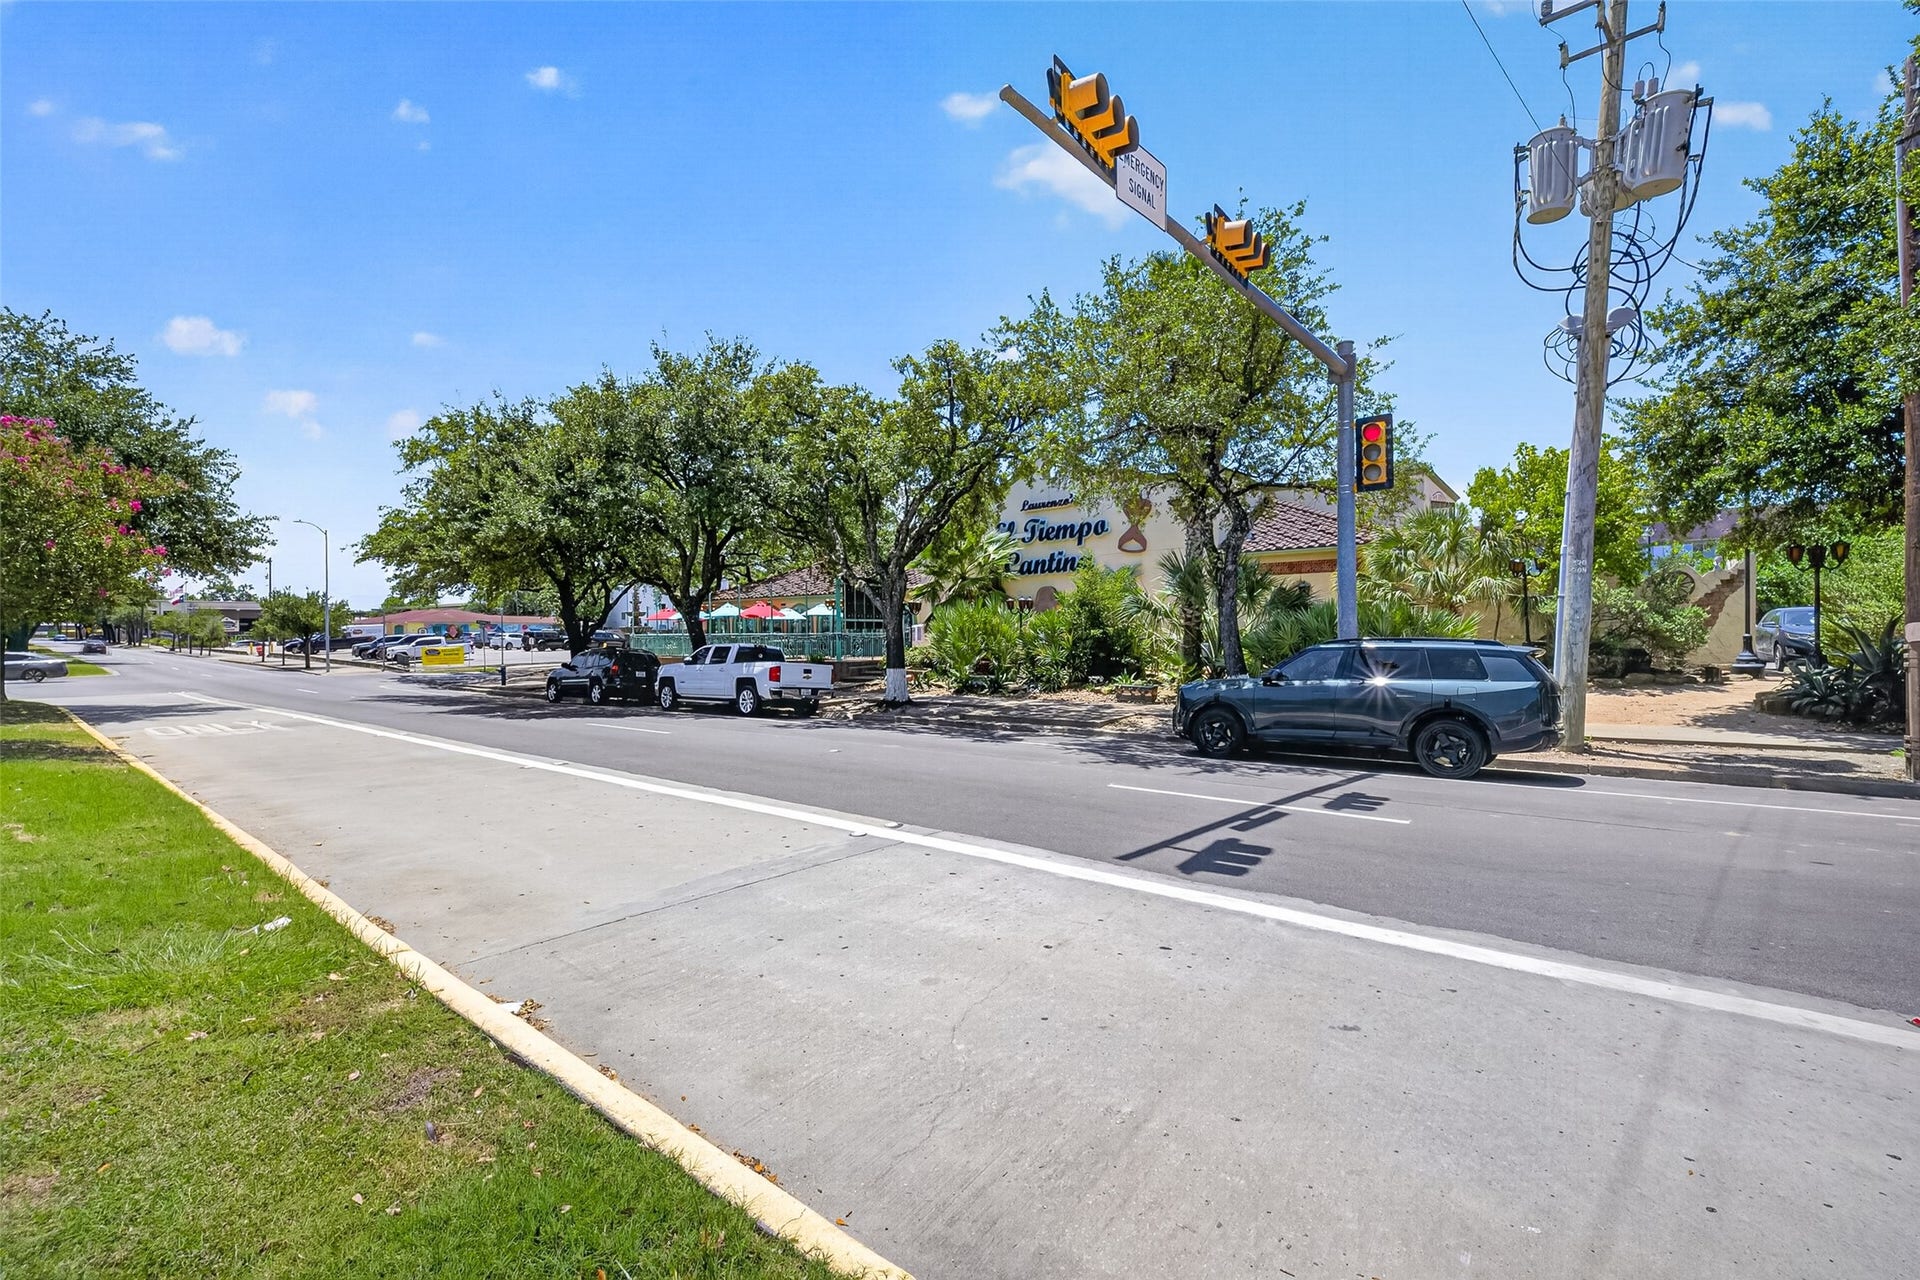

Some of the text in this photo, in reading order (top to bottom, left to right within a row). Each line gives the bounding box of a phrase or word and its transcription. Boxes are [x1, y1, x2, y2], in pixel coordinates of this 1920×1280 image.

[1128, 178, 1156, 210] SIGNAL
[1022, 518, 1109, 546] Tiempo
[1004, 550, 1079, 575] Cantin
[143, 720, 292, 739] ONLY
